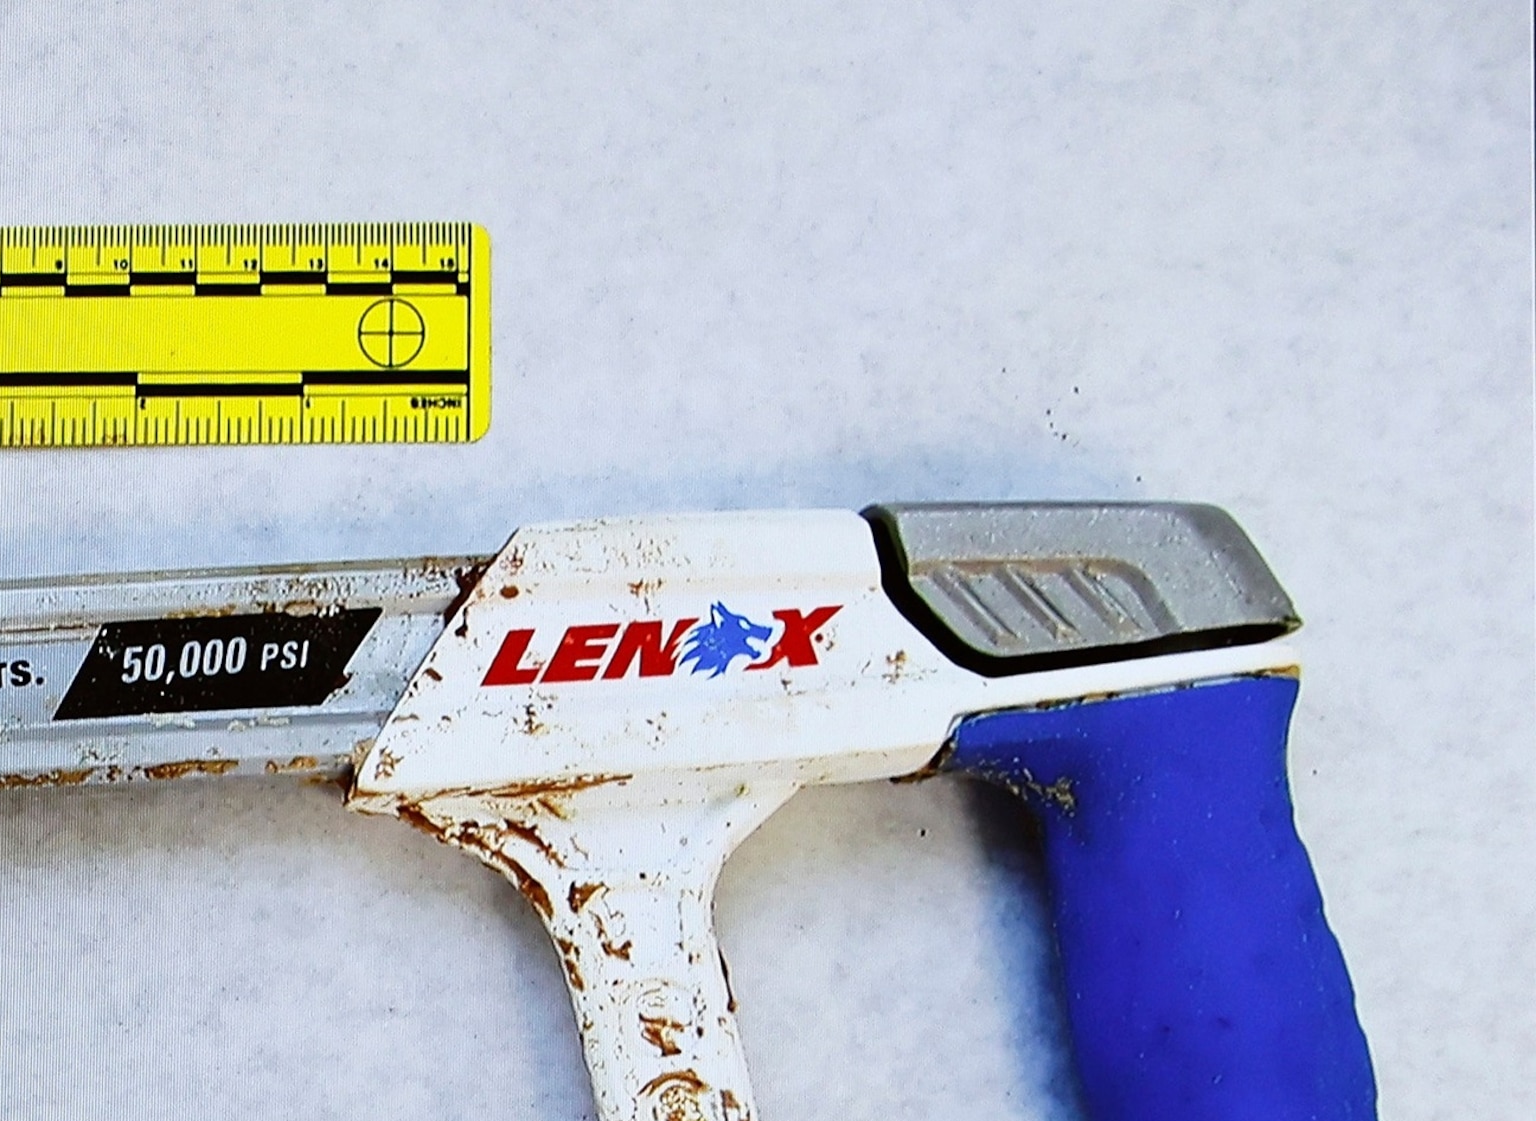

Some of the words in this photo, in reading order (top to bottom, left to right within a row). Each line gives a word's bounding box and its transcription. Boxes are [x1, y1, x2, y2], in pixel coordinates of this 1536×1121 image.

[113, 259, 129, 270] 10
[180, 258, 195, 269] 11
[243, 258, 259, 269] 12
[309, 258, 324, 269] 13
[374, 258, 390, 269] 14
[440, 257, 456, 269] 15
[410, 397, 462, 409] INCHES
[121, 637, 247, 685] 50,000
[260, 639, 310, 671] PSI
